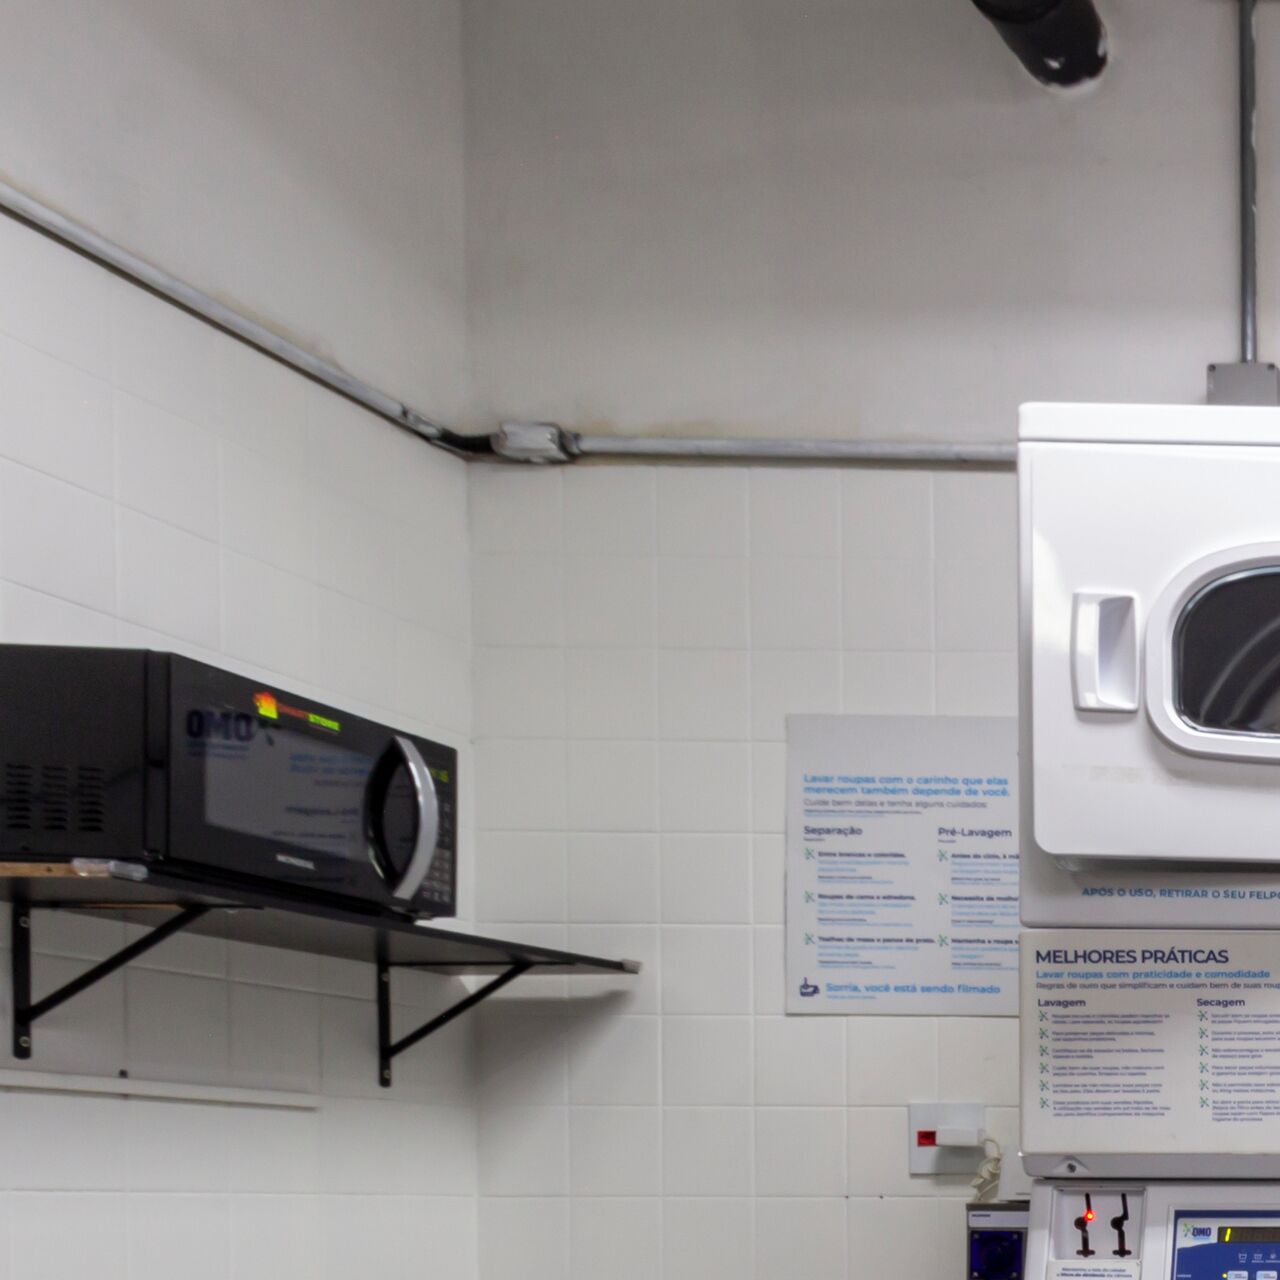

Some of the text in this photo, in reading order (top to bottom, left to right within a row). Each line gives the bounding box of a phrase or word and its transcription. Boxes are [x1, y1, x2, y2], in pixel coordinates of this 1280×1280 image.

[804, 825, 862, 837] Separação
[938, 826, 1011, 839] Pré-Lavagem
[1082, 887, 1114, 898] APÓS
[1117, 888, 1125, 898] O
[1129, 888, 1156, 899] USO,
[1159, 889, 1208, 899] RETIRAR
[1209, 889, 1220, 900] O
[1223, 890, 1246, 900] SEU
[1036, 947, 1228, 964] MELHORES PRÁTICAS
[1036, 969, 1269, 981] Lavar roupas com praticidade e comodidade
[826, 983, 1001, 995] Sorria, você está sendo filmado
[1038, 998, 1085, 1010] Lavagem
[1196, 998, 1244, 1010] Secagem
